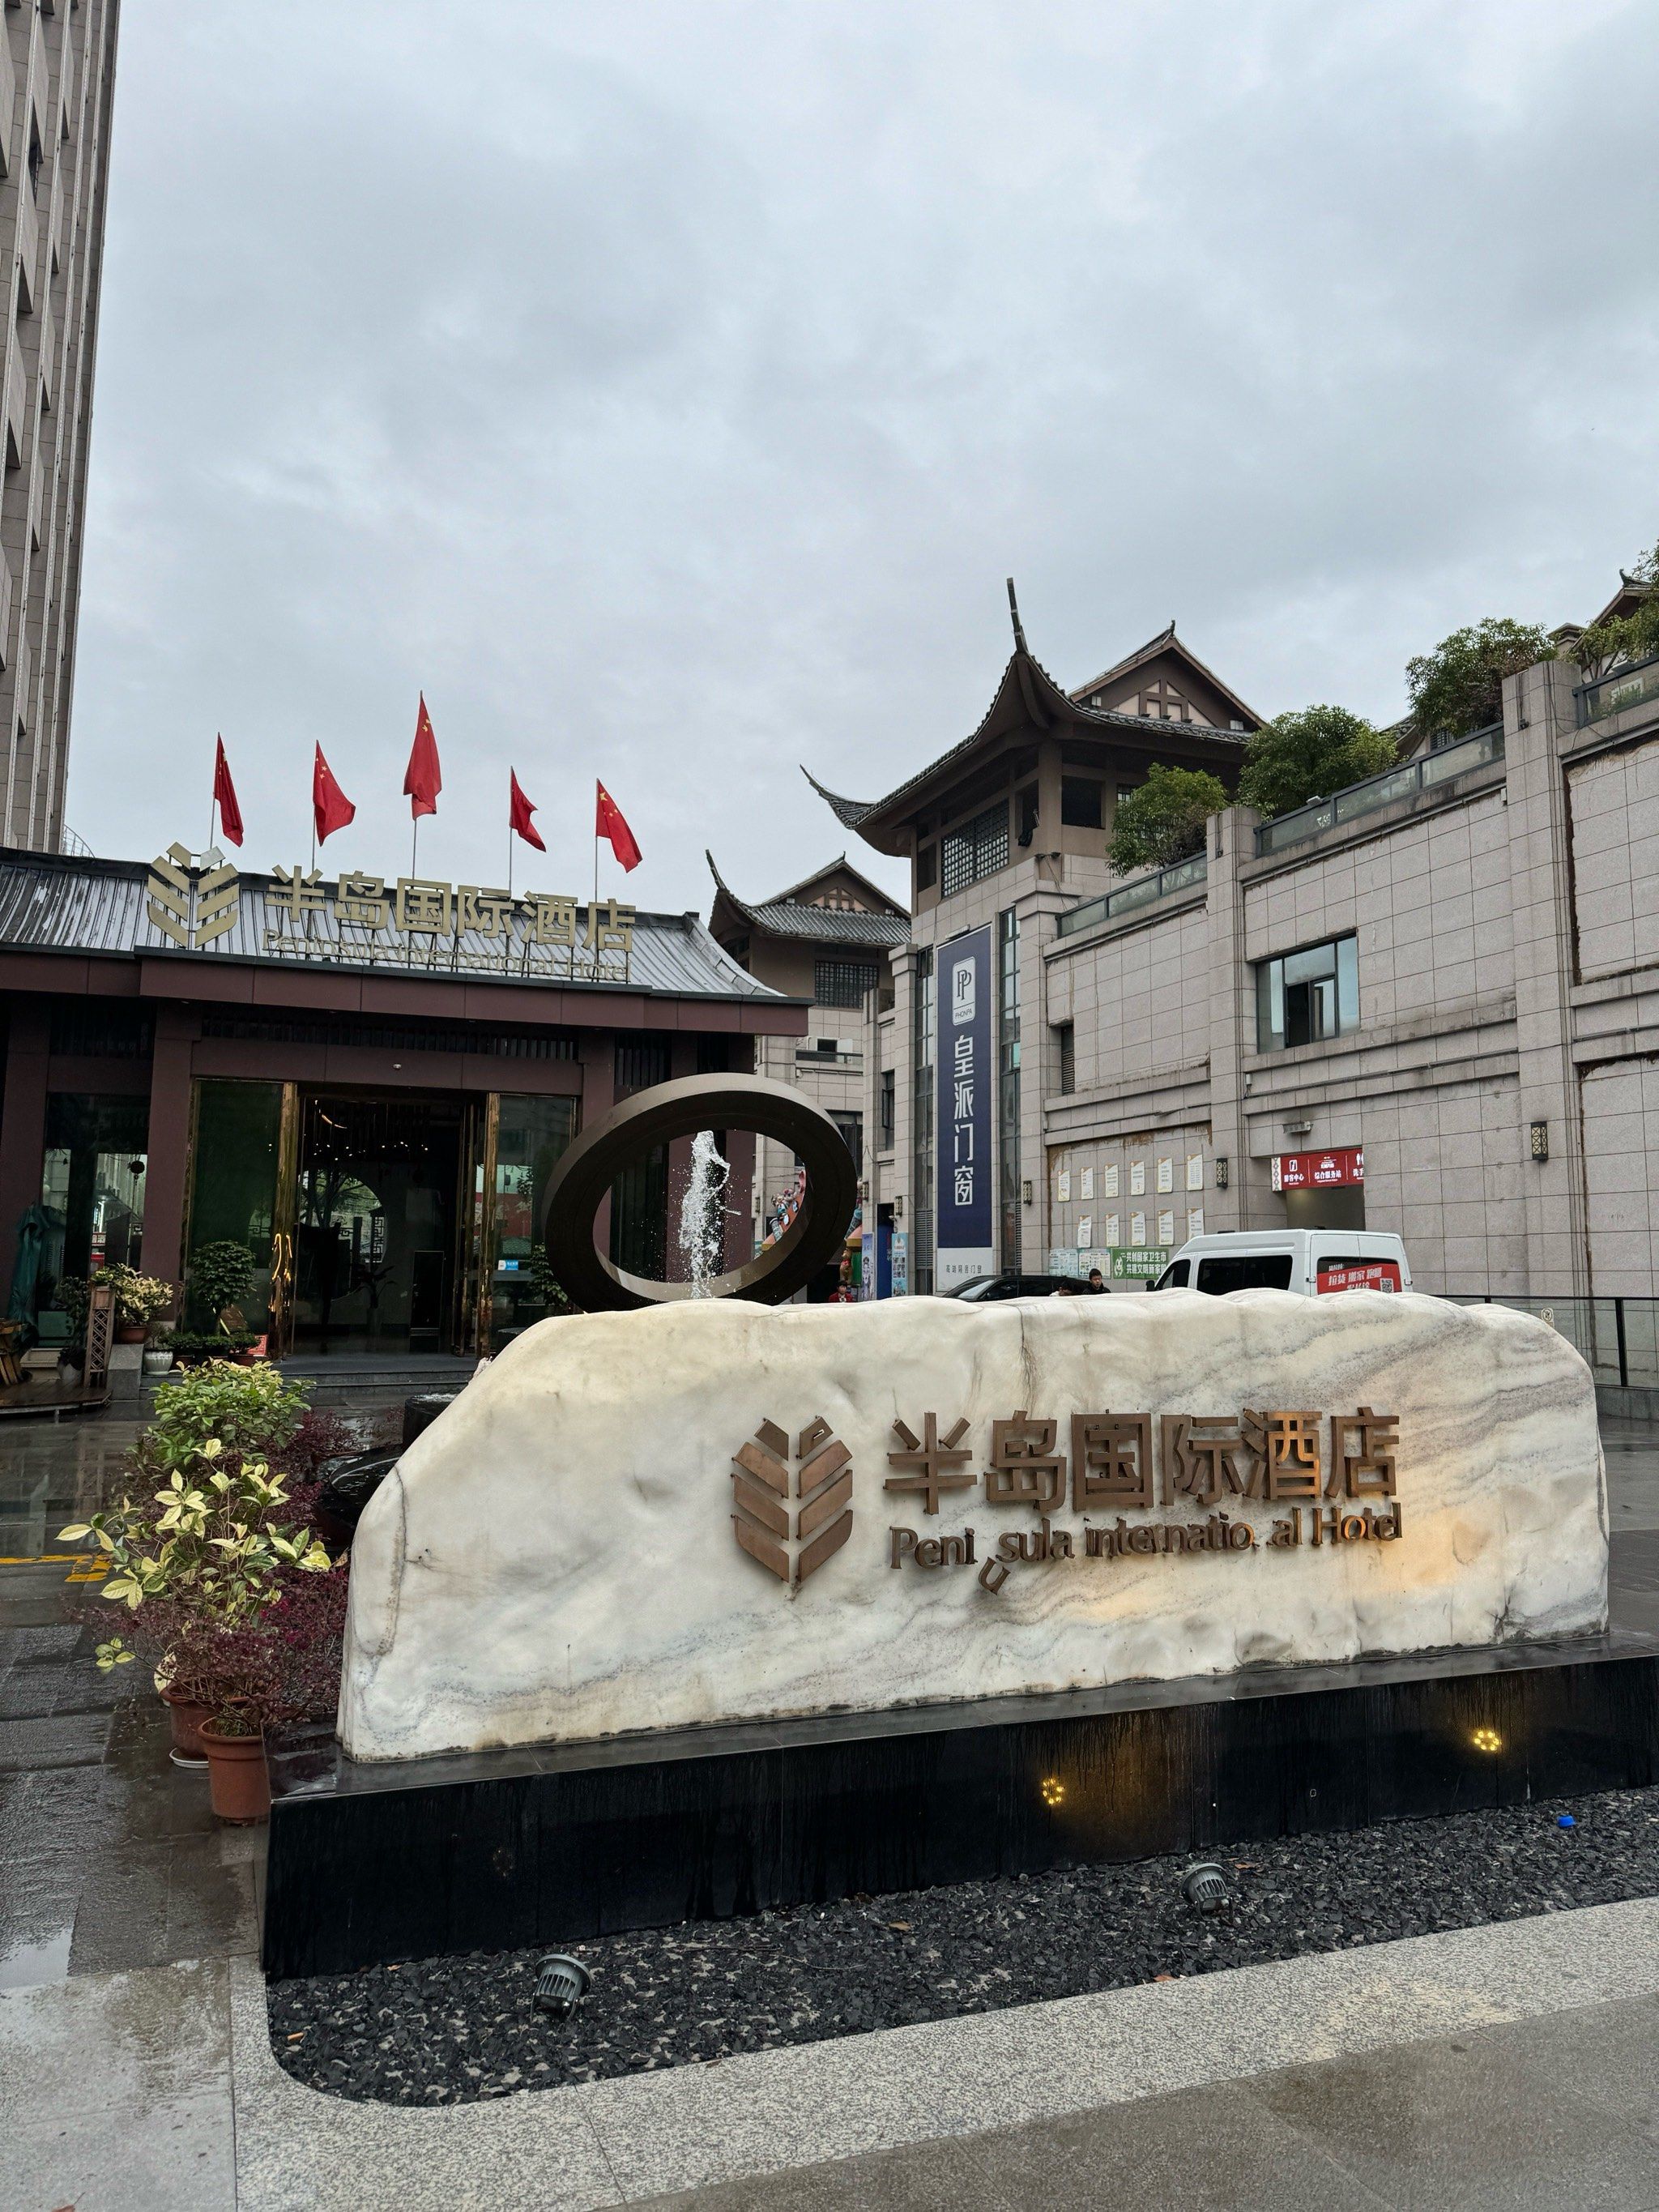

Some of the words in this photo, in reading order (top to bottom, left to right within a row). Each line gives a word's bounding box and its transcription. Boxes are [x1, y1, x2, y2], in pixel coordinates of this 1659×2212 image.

[265, 865, 638, 951] 半岛国际酒店
[262, 929, 390, 960] Peninsula
[566, 956, 631, 982] Hotel
[954, 1034, 975, 1206] 皇派门窗
[1314, 1169, 1341, 1180] 综合服务站
[885, 1407, 1400, 1515] 半岛国际酒店
[1085, 1507, 1303, 1558] internatioal
[1311, 1501, 1403, 1545] Hotel
